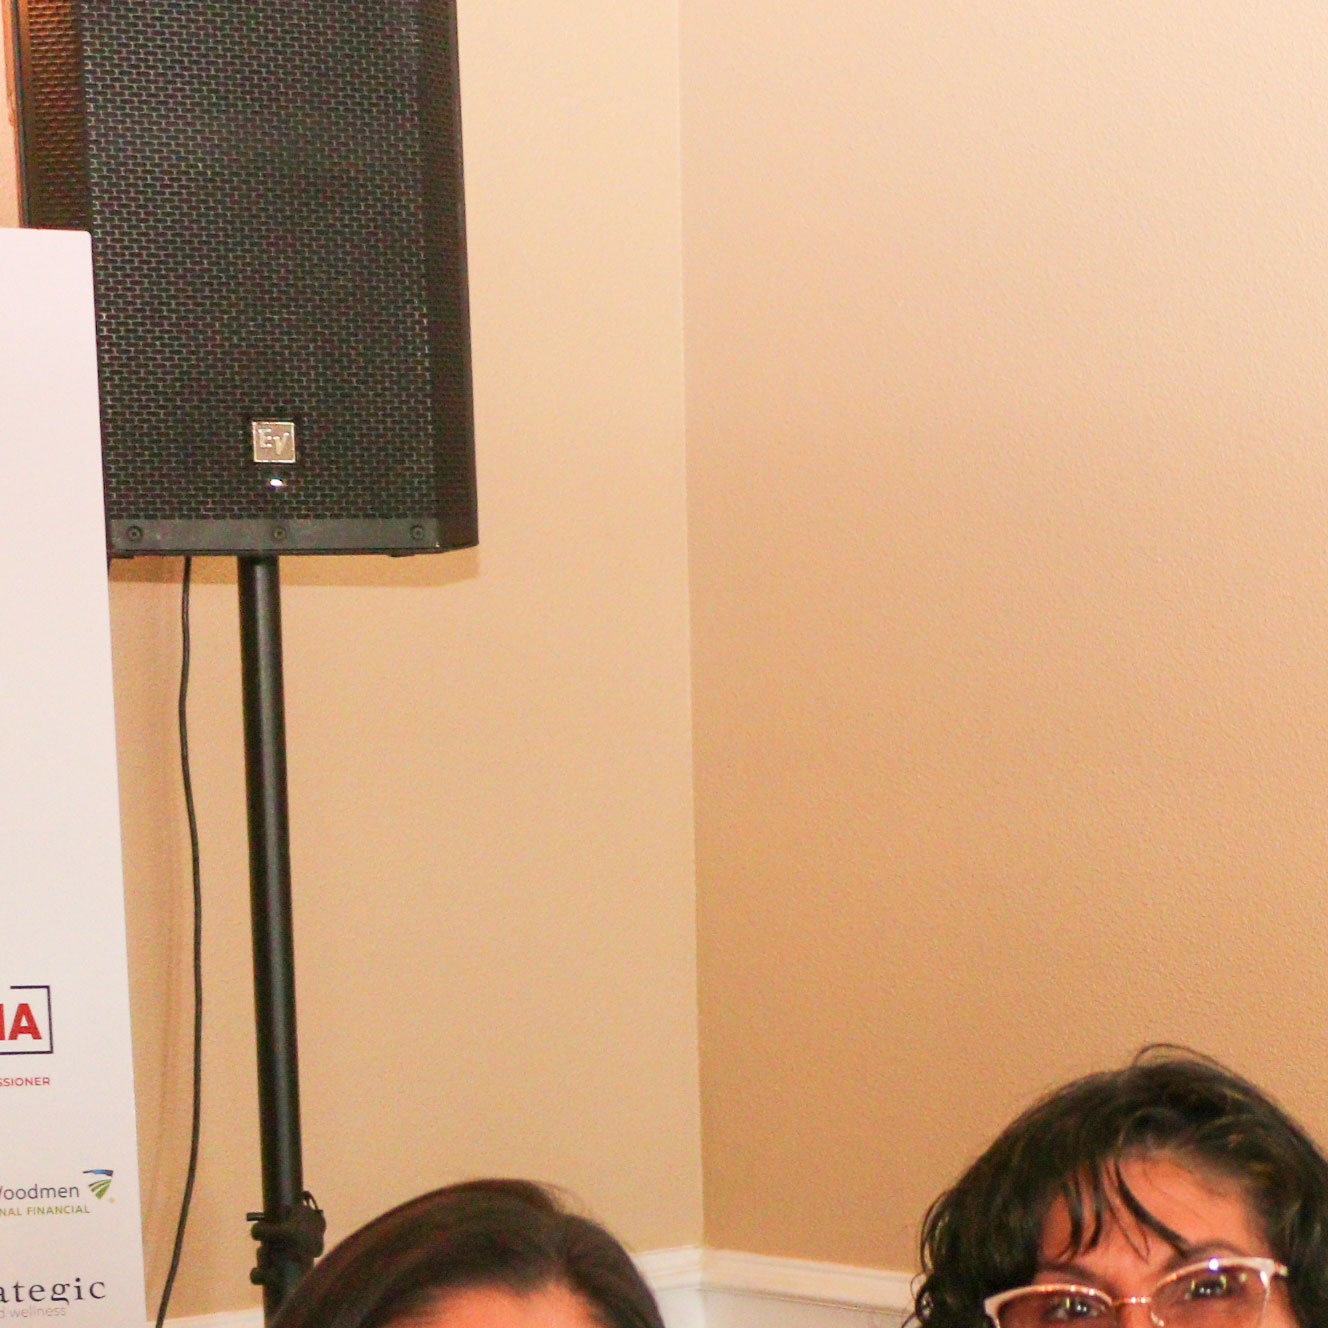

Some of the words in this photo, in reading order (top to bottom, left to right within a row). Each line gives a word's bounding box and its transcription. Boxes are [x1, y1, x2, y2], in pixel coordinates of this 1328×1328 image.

[258, 428, 290, 455] EV
[0, 1003, 42, 1041] A
[0, 1184, 80, 1200] oodmen
[27, 1205, 91, 1215] FINANCIAL
[10, 1304, 67, 1319] wellness
